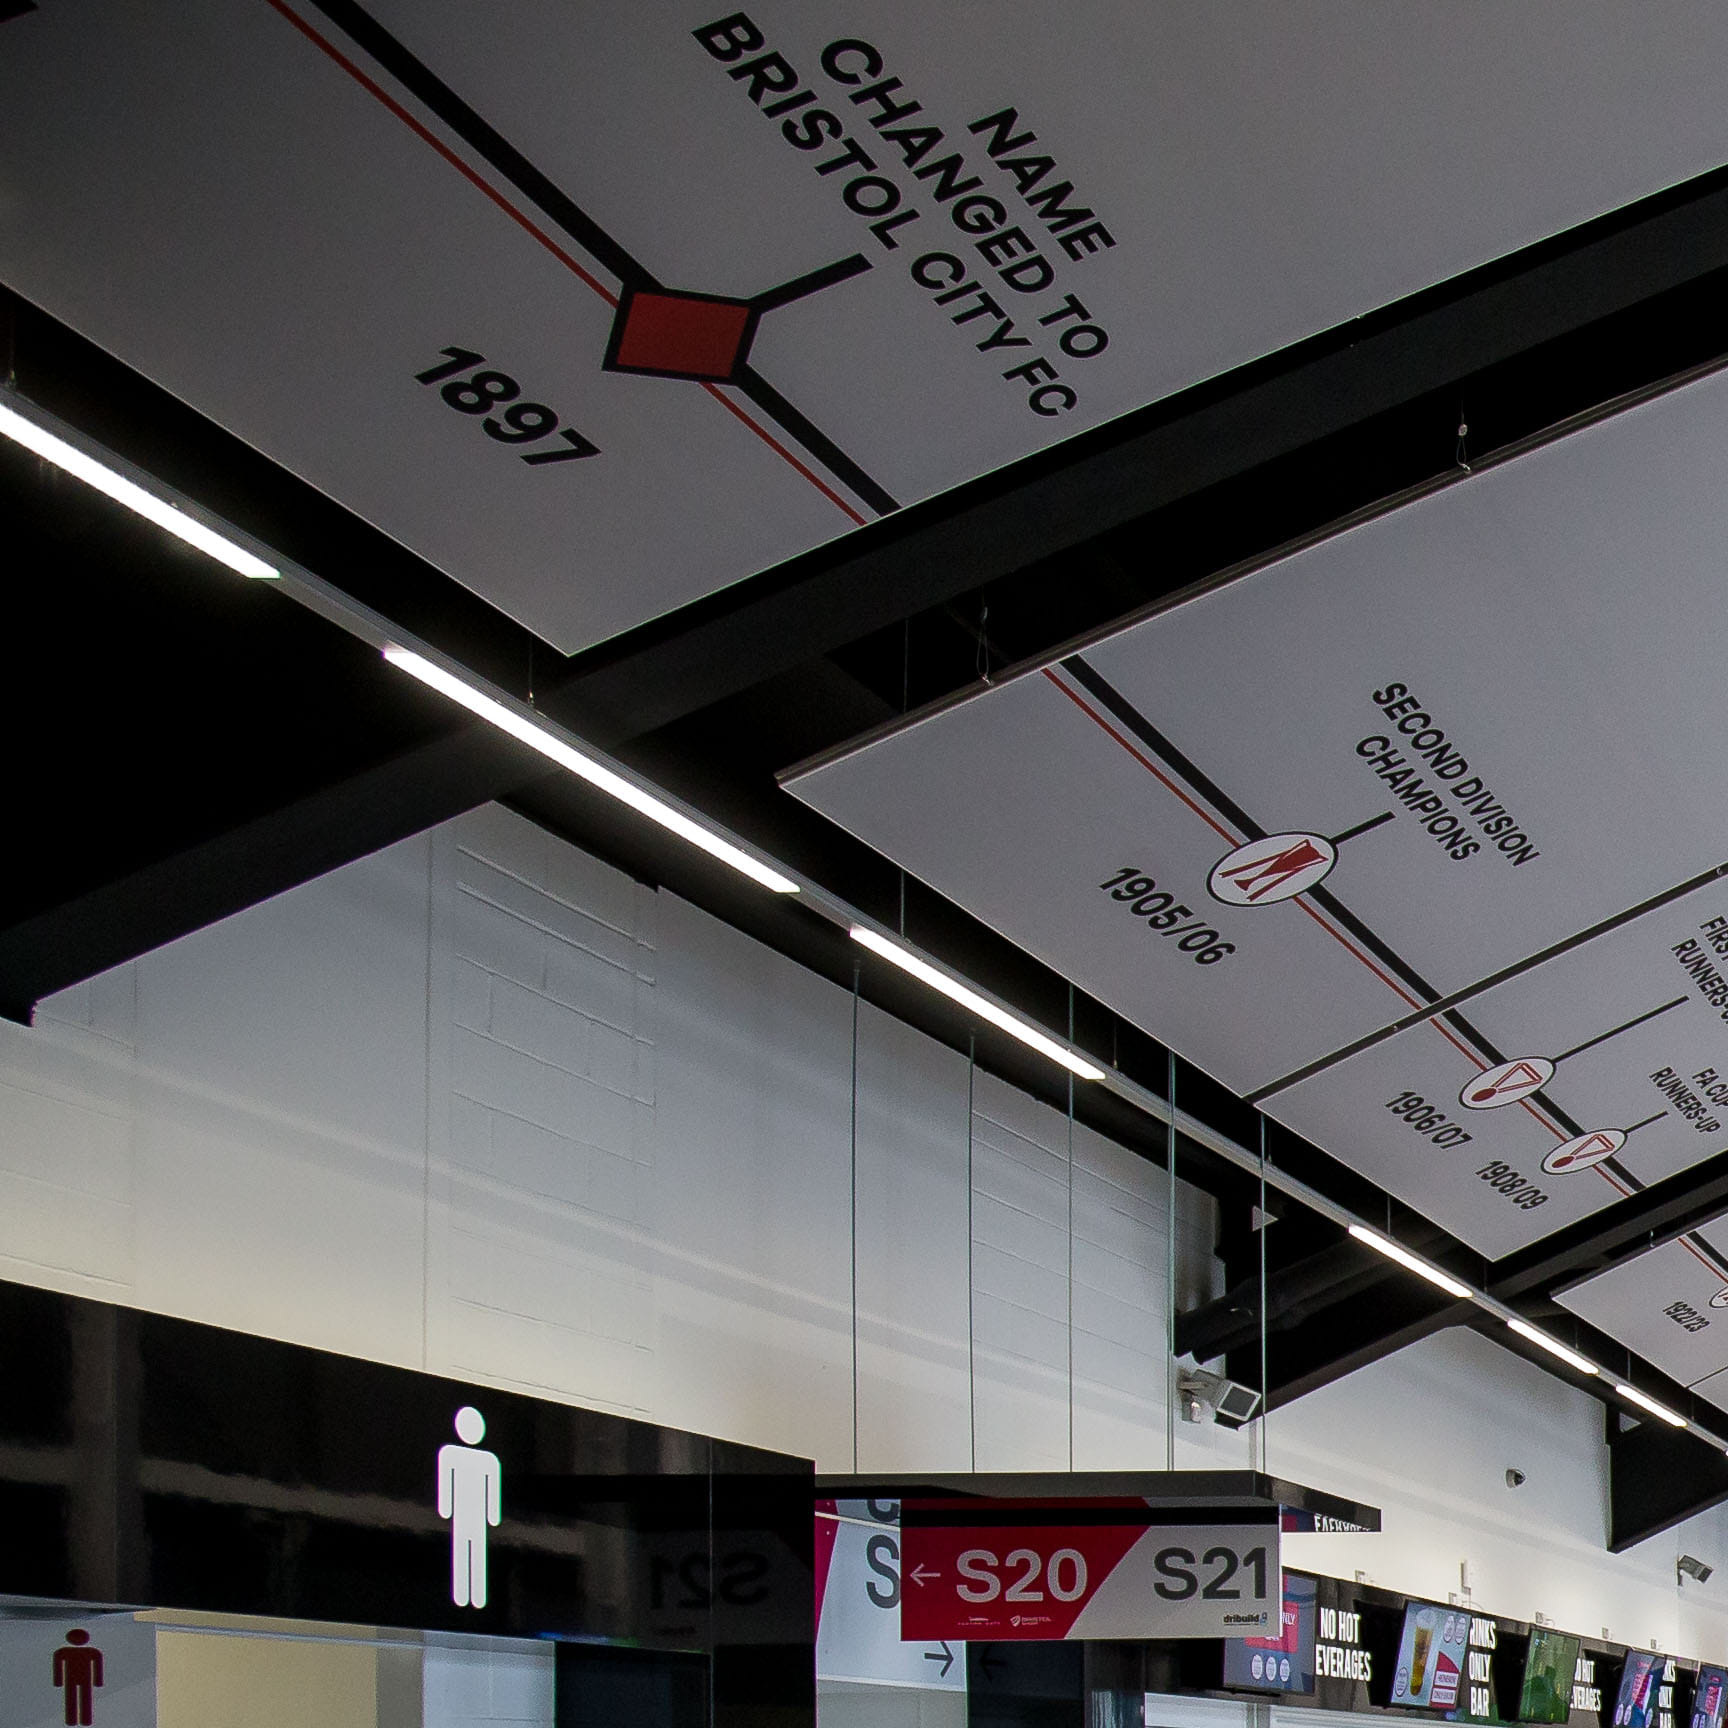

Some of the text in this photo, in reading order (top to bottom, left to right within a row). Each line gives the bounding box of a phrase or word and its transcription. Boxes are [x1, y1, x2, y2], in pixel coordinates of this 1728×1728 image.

[820, 38, 1109, 360] CHANGED TO
[967, 107, 1117, 261] NAME
[692, 10, 1078, 418] BRISTOL CITY FC
[413, 345, 602, 466] 1897
[1355, 735, 1481, 861] CHAMPIONS
[1372, 683, 1541, 867] SECOND DIVISION
[1098, 867, 1236, 966] 1905/06
[1649, 1066, 1721, 1133] RUNNERS-UP
[1692, 1067, 1719, 1089] FA
[1385, 1091, 1473, 1149] 1906/07
[1475, 1161, 1549, 1210] 1908/09
[1663, 1301, 1710, 1333] 1922/23
[956, 1549, 1088, 1603] S20
[1153, 1547, 1267, 1600] S21
[1223, 1613, 1260, 1624] dribuild
[1320, 1608, 1360, 1643] NO HOT
[1316, 1644, 1371, 1682] EVERAGES
[1469, 1651, 1491, 1682] ONLY
[1470, 1686, 1489, 1717] BAR
